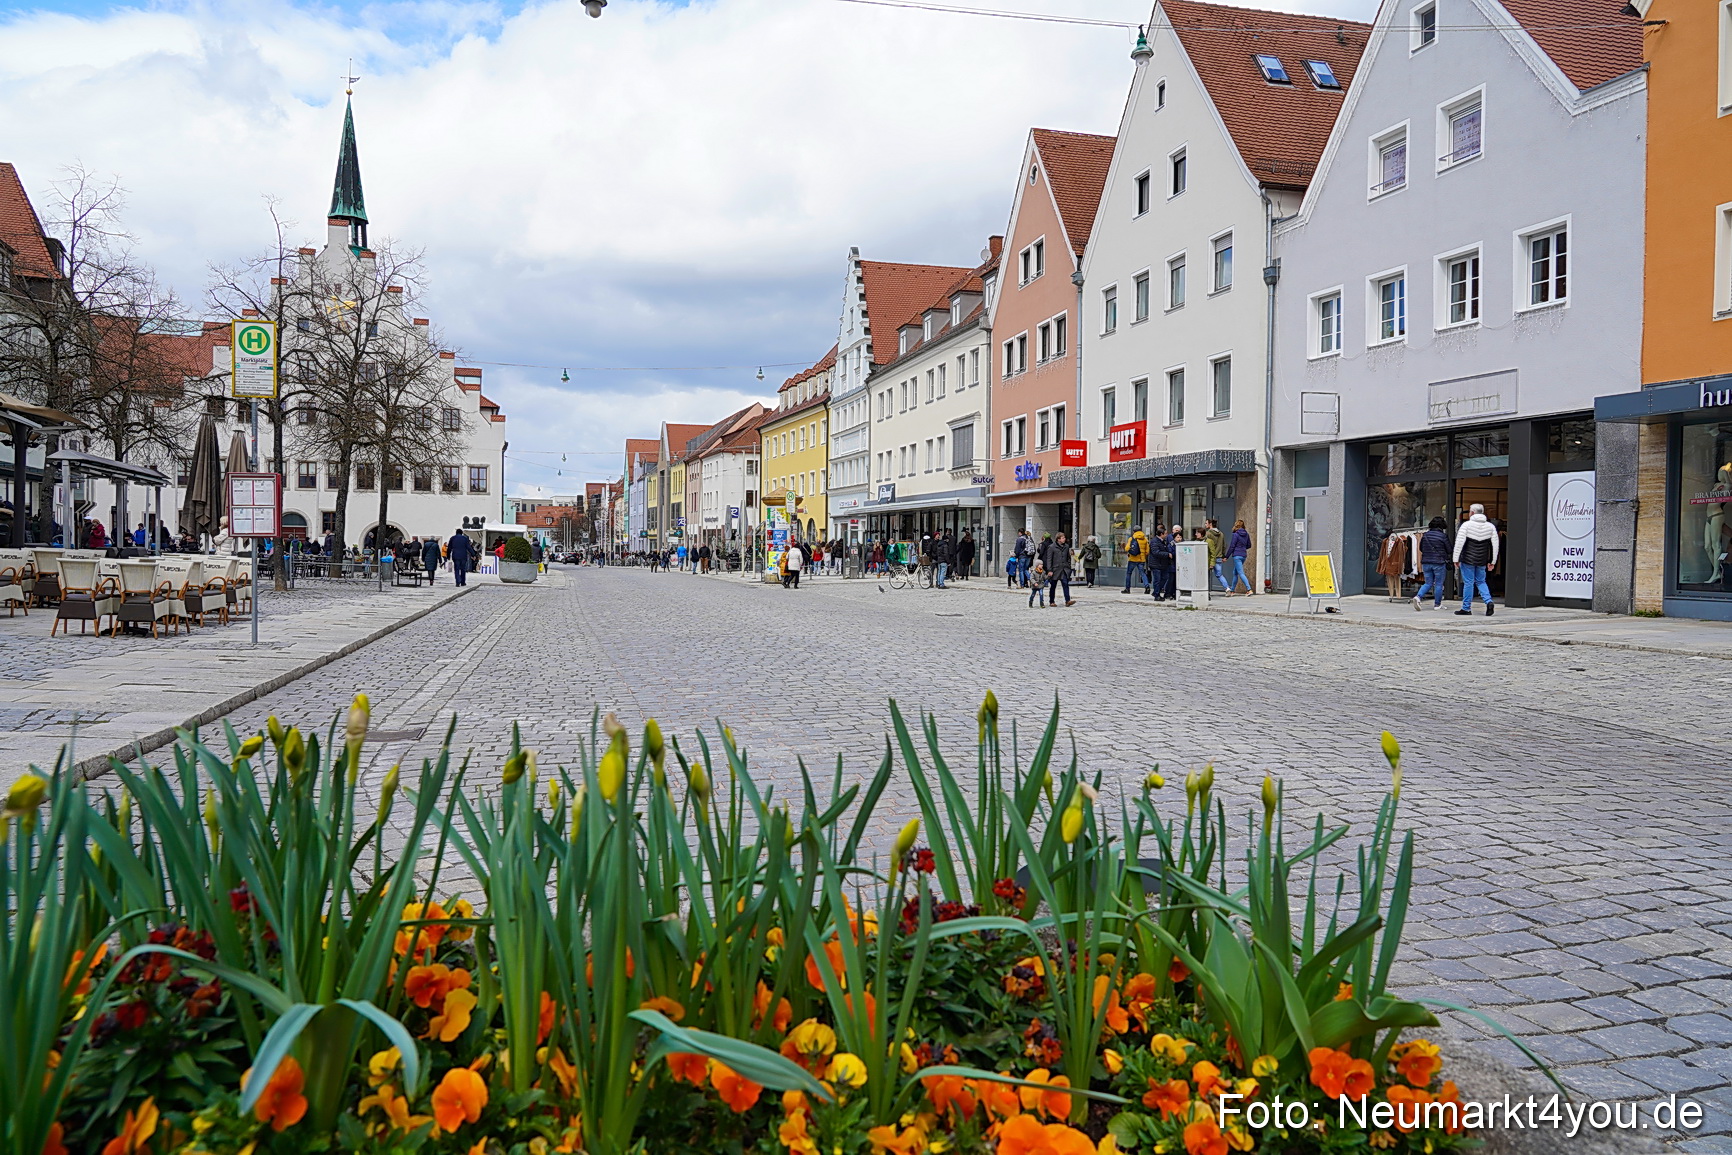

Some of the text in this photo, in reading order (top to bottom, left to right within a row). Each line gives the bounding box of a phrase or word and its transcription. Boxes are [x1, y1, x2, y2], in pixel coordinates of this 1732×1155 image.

[247, 332, 262, 349] H
[1111, 428, 1136, 449] WITT
[1065, 448, 1084, 456] WITT
[1562, 547, 1584, 556] NEW
[1551, 572, 1593, 582] 25.03.202
